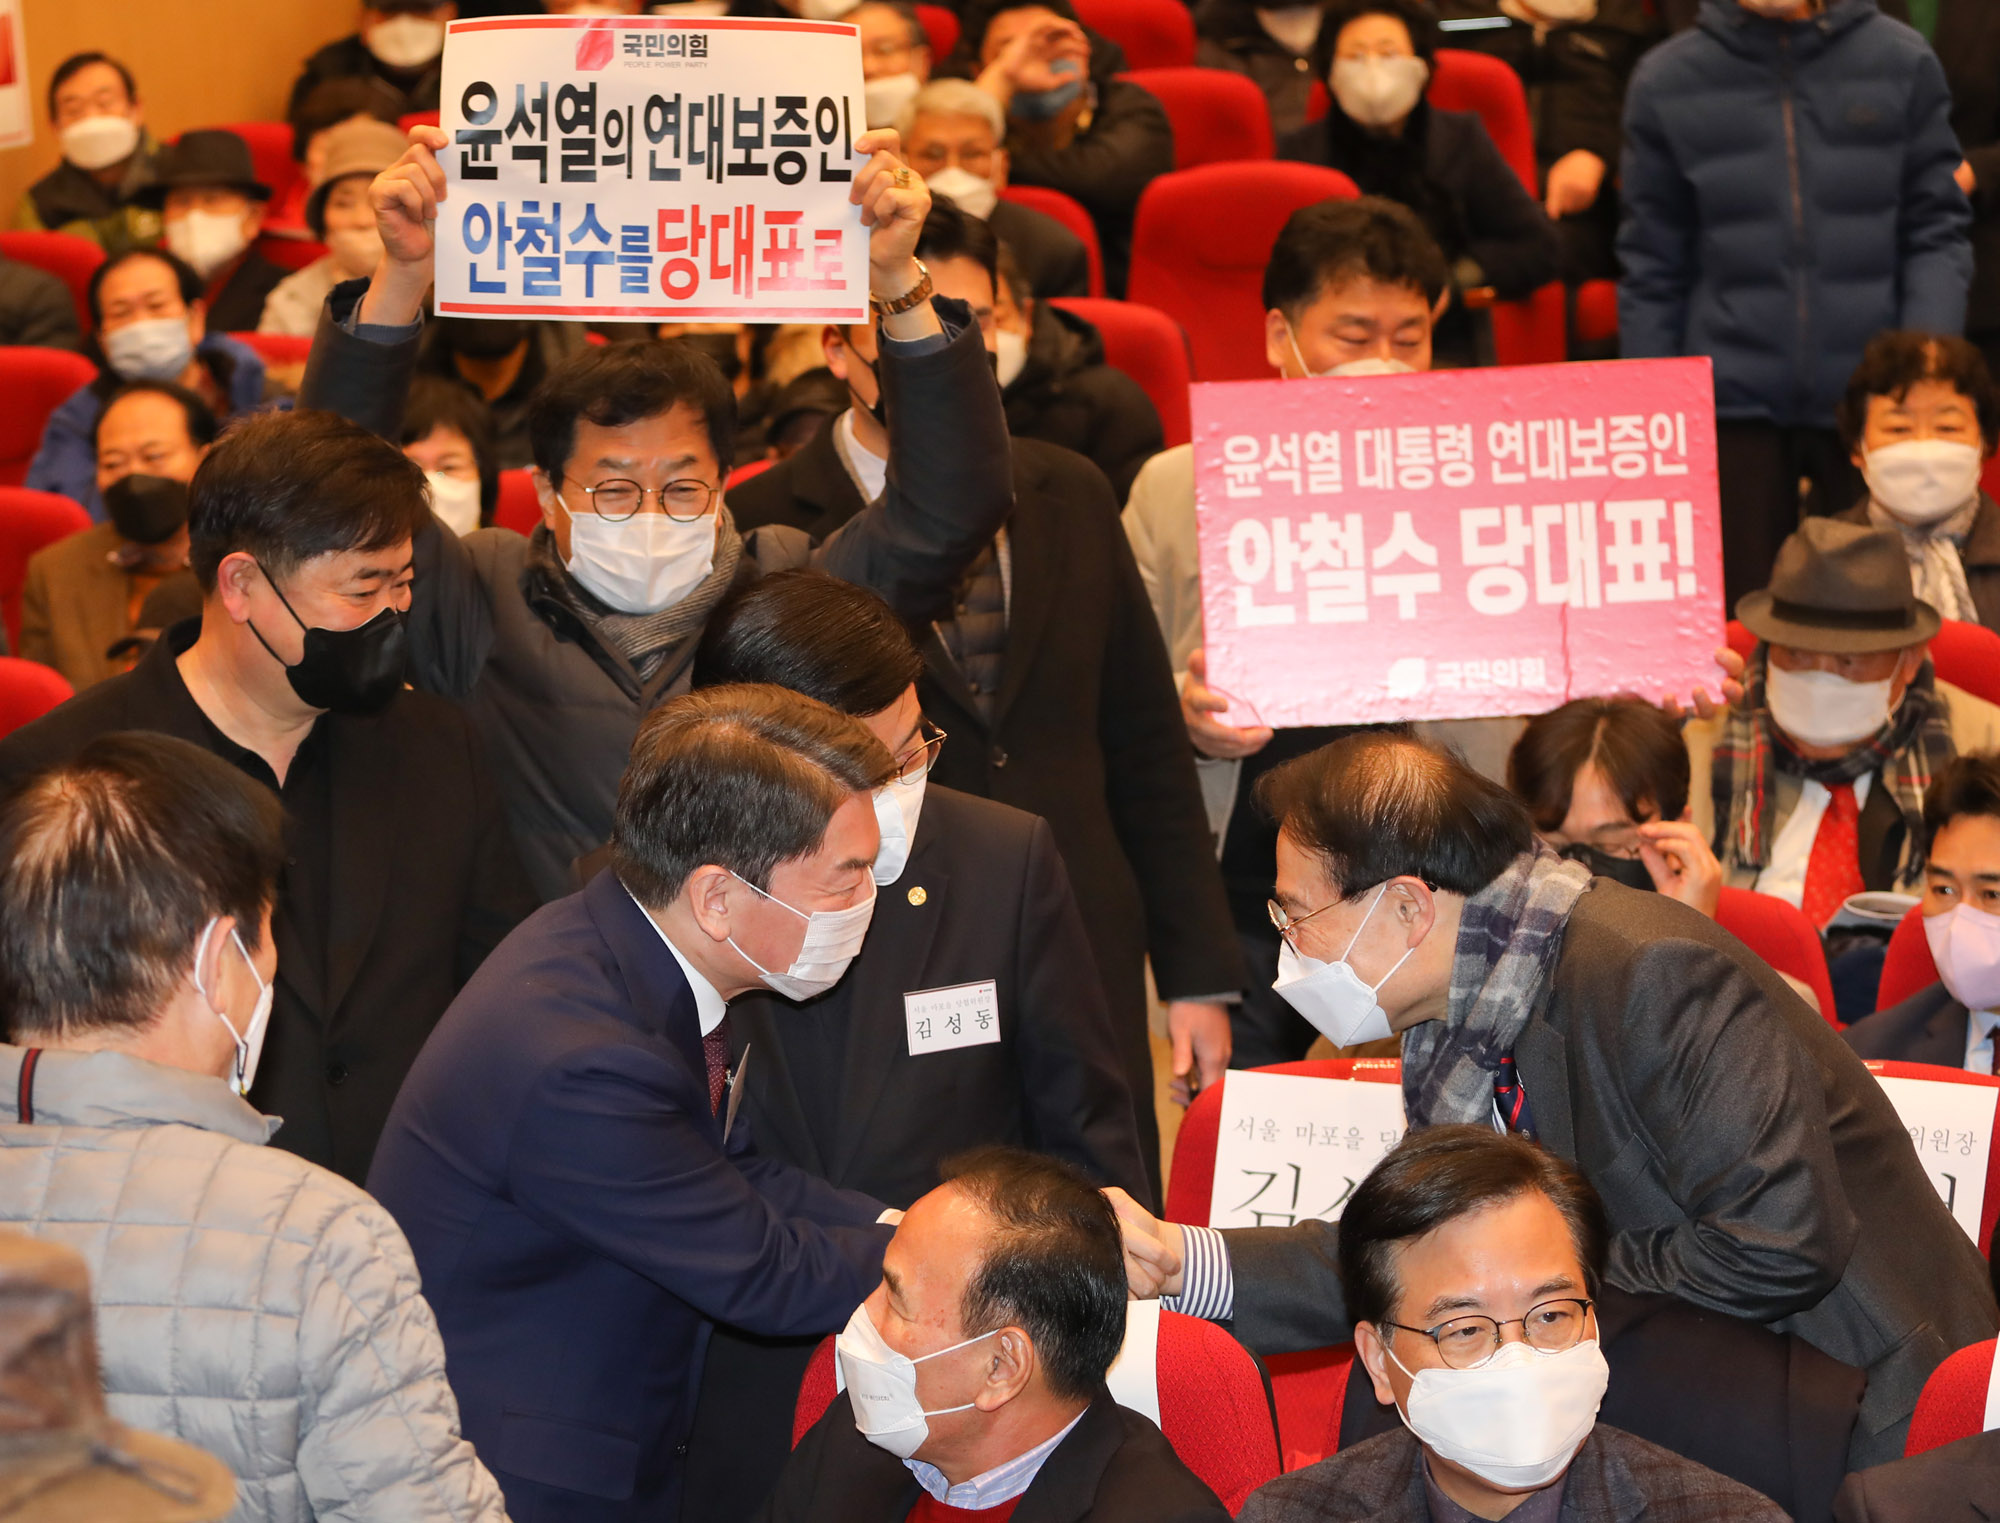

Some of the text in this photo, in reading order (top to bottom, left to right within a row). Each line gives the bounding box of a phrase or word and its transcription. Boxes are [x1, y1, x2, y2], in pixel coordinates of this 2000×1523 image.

[622, 34, 708, 58] 국민의힘
[455, 81, 852, 185] 윤석열의 연대보증인
[1222, 412, 1689, 498] 윤석열 대통령 연대보증인
[1227, 499, 1698, 628] 안철수 당대표!
[1433, 658, 1547, 690] 국민의힘
[1232, 1115, 1281, 1143] 서울
[1295, 1121, 1365, 1151] 마포을
